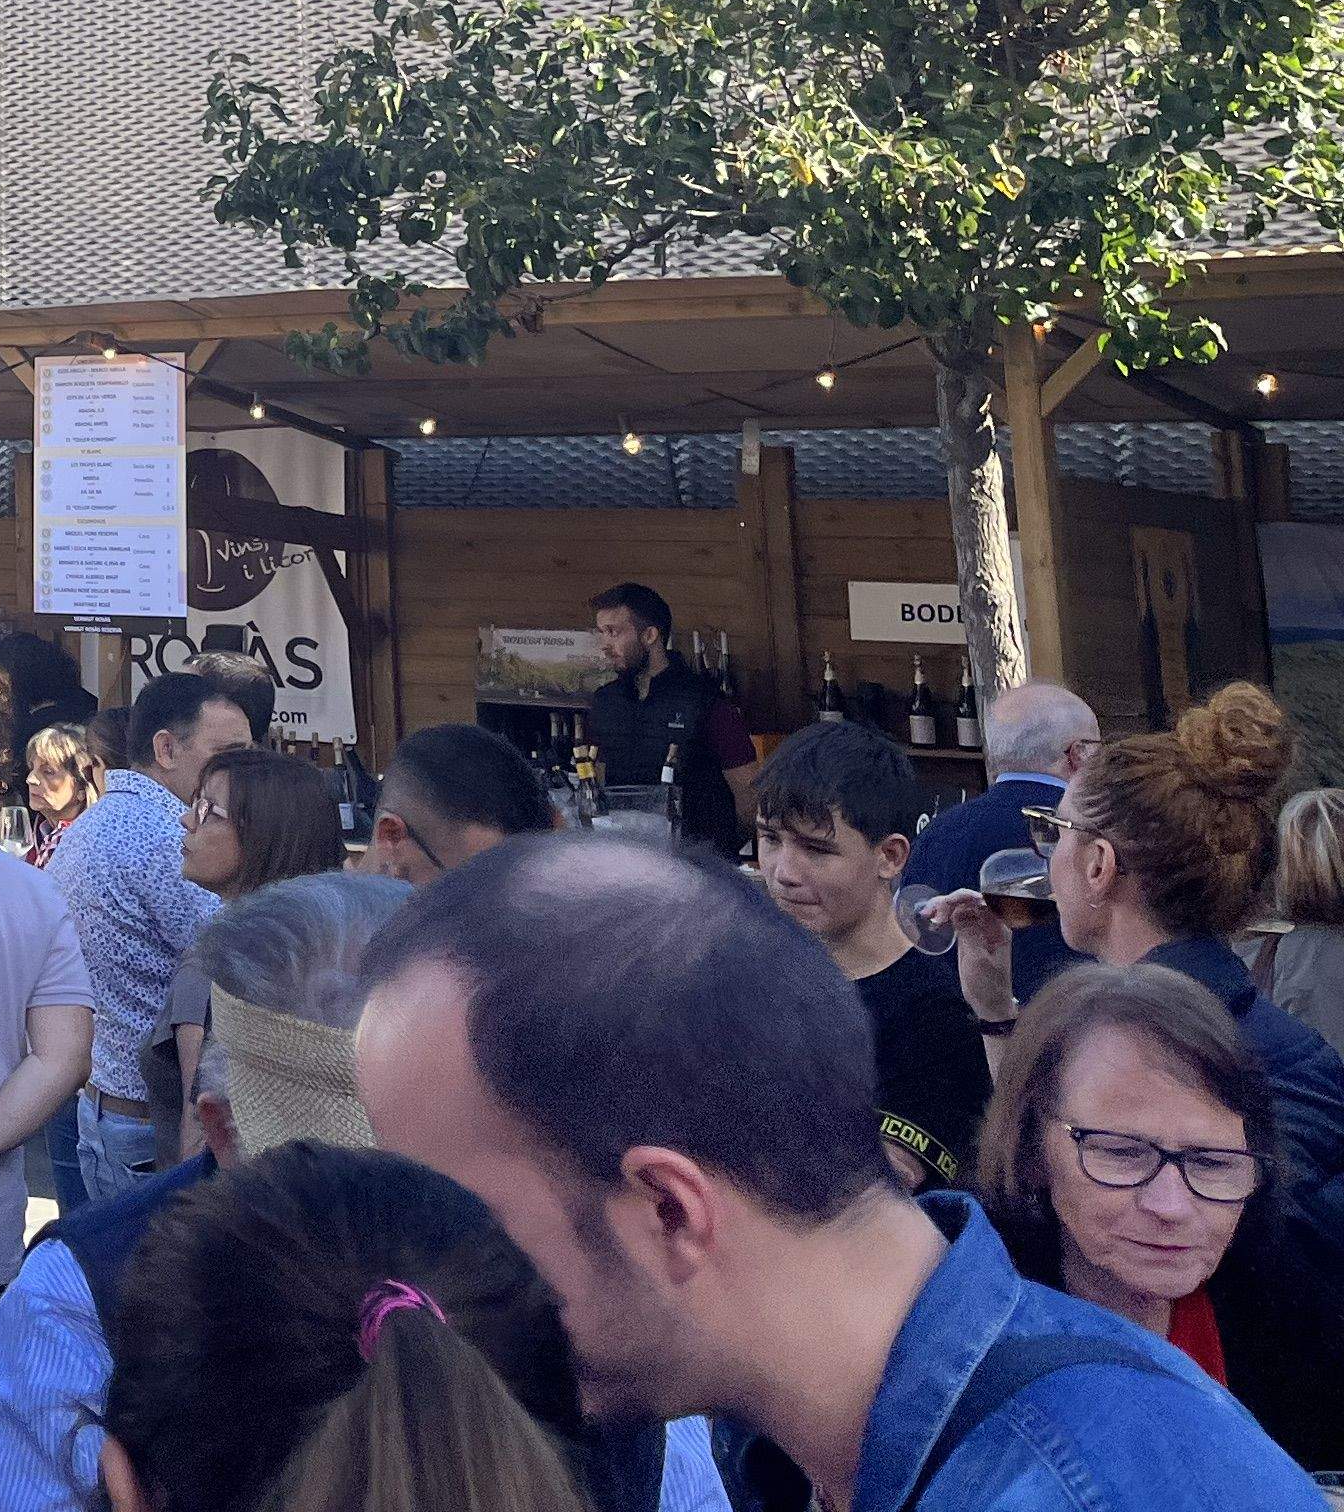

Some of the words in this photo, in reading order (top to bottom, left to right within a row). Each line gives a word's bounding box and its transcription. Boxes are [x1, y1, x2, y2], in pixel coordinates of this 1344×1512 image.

[901, 603, 965, 624] BOD
[131, 620, 323, 690] ROÀS
[880, 1117, 930, 1153] ICON
